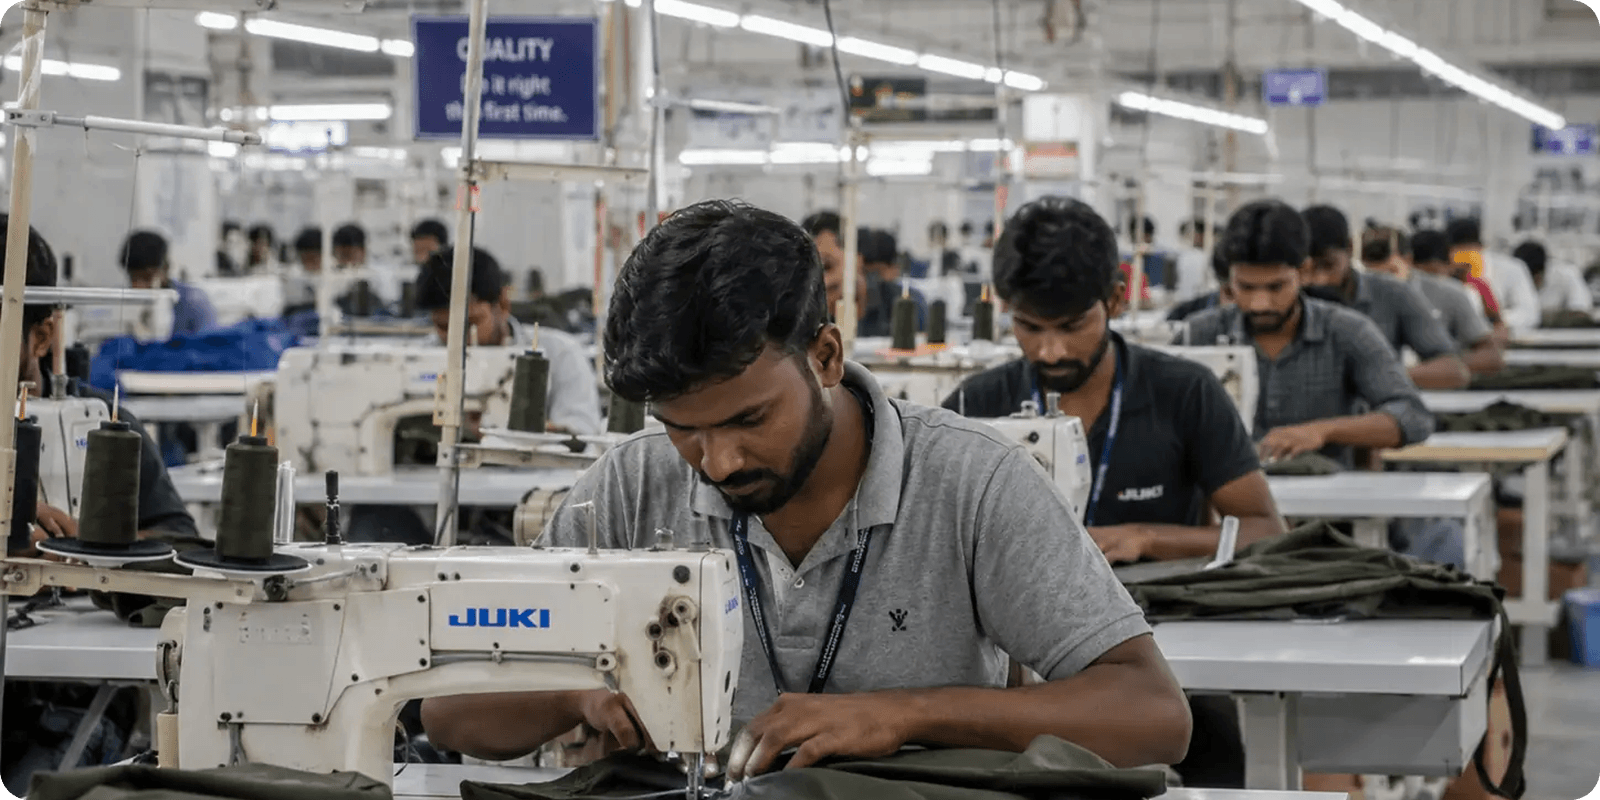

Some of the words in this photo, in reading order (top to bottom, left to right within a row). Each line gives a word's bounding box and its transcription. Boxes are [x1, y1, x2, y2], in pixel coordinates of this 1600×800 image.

[491, 74, 505, 95] it
[508, 74, 551, 100] right
[445, 101, 482, 122] th
[484, 100, 520, 122] first
[523, 102, 569, 123] time.
[448, 607, 550, 628] JUKI
